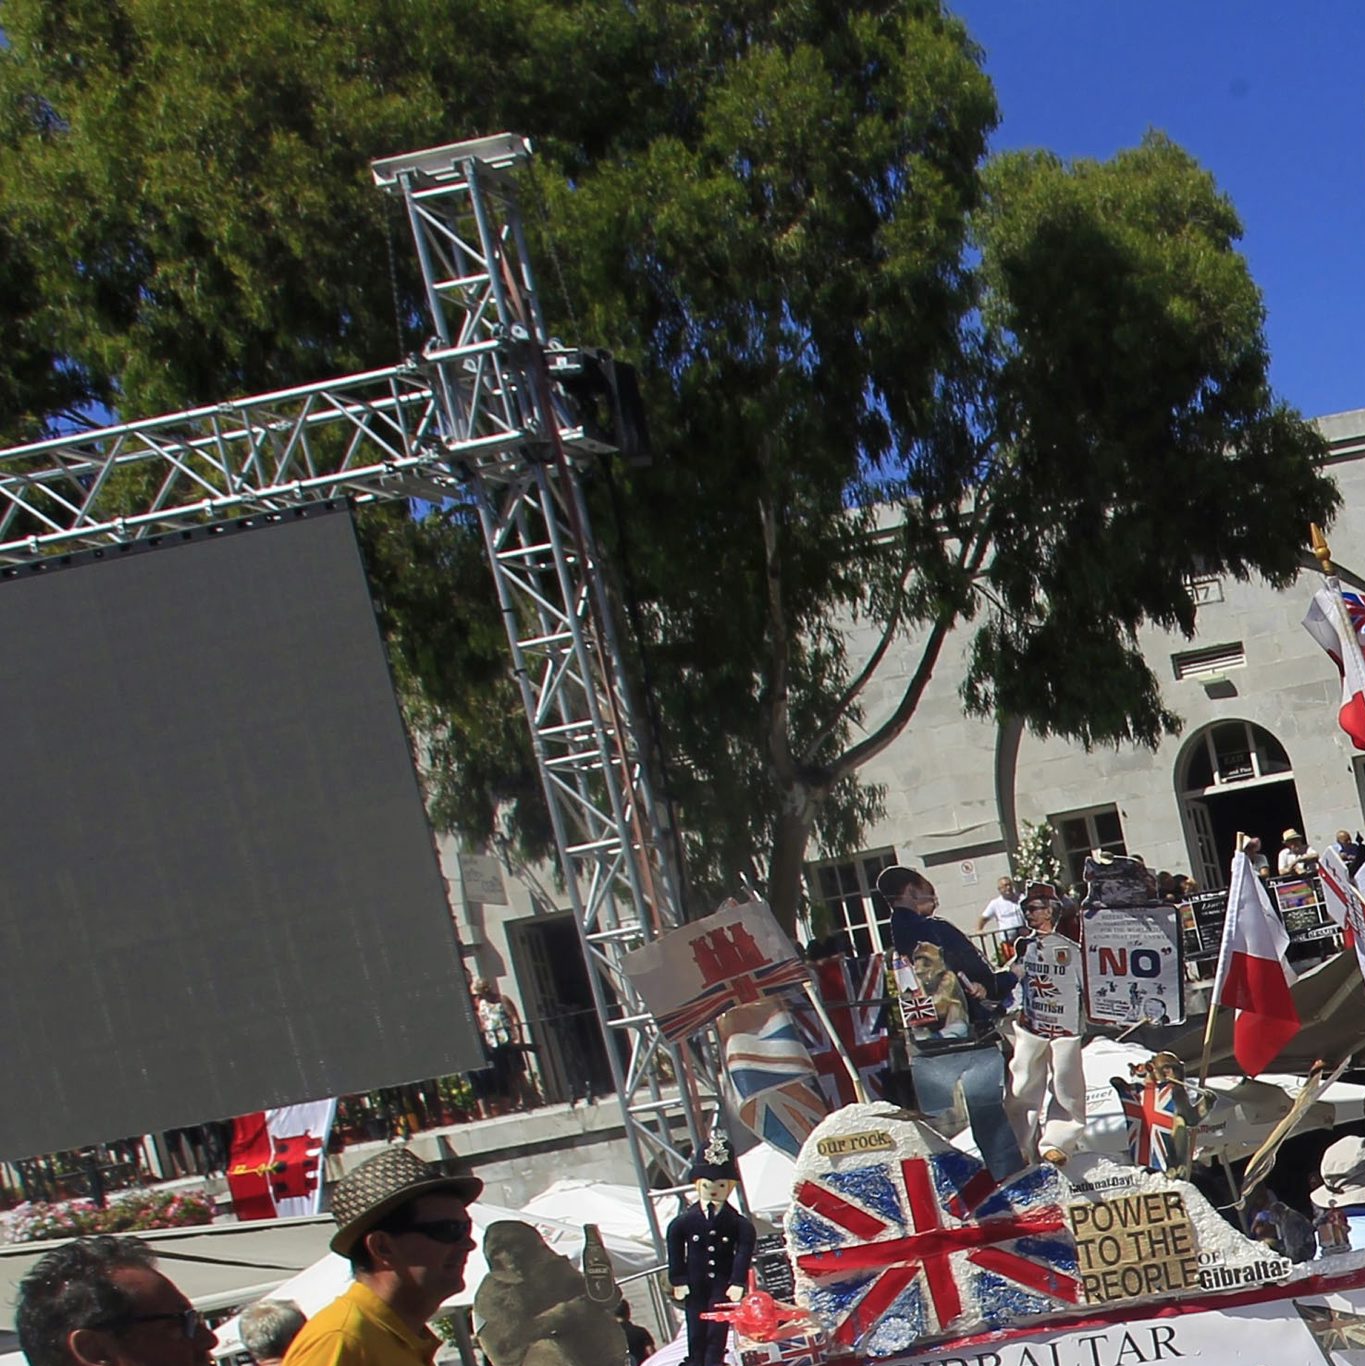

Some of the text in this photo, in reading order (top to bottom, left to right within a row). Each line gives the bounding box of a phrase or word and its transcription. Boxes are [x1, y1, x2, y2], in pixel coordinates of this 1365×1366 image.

[1069, 1191, 1186, 1235] POWER
[1077, 1224, 1191, 1269] TO THE
